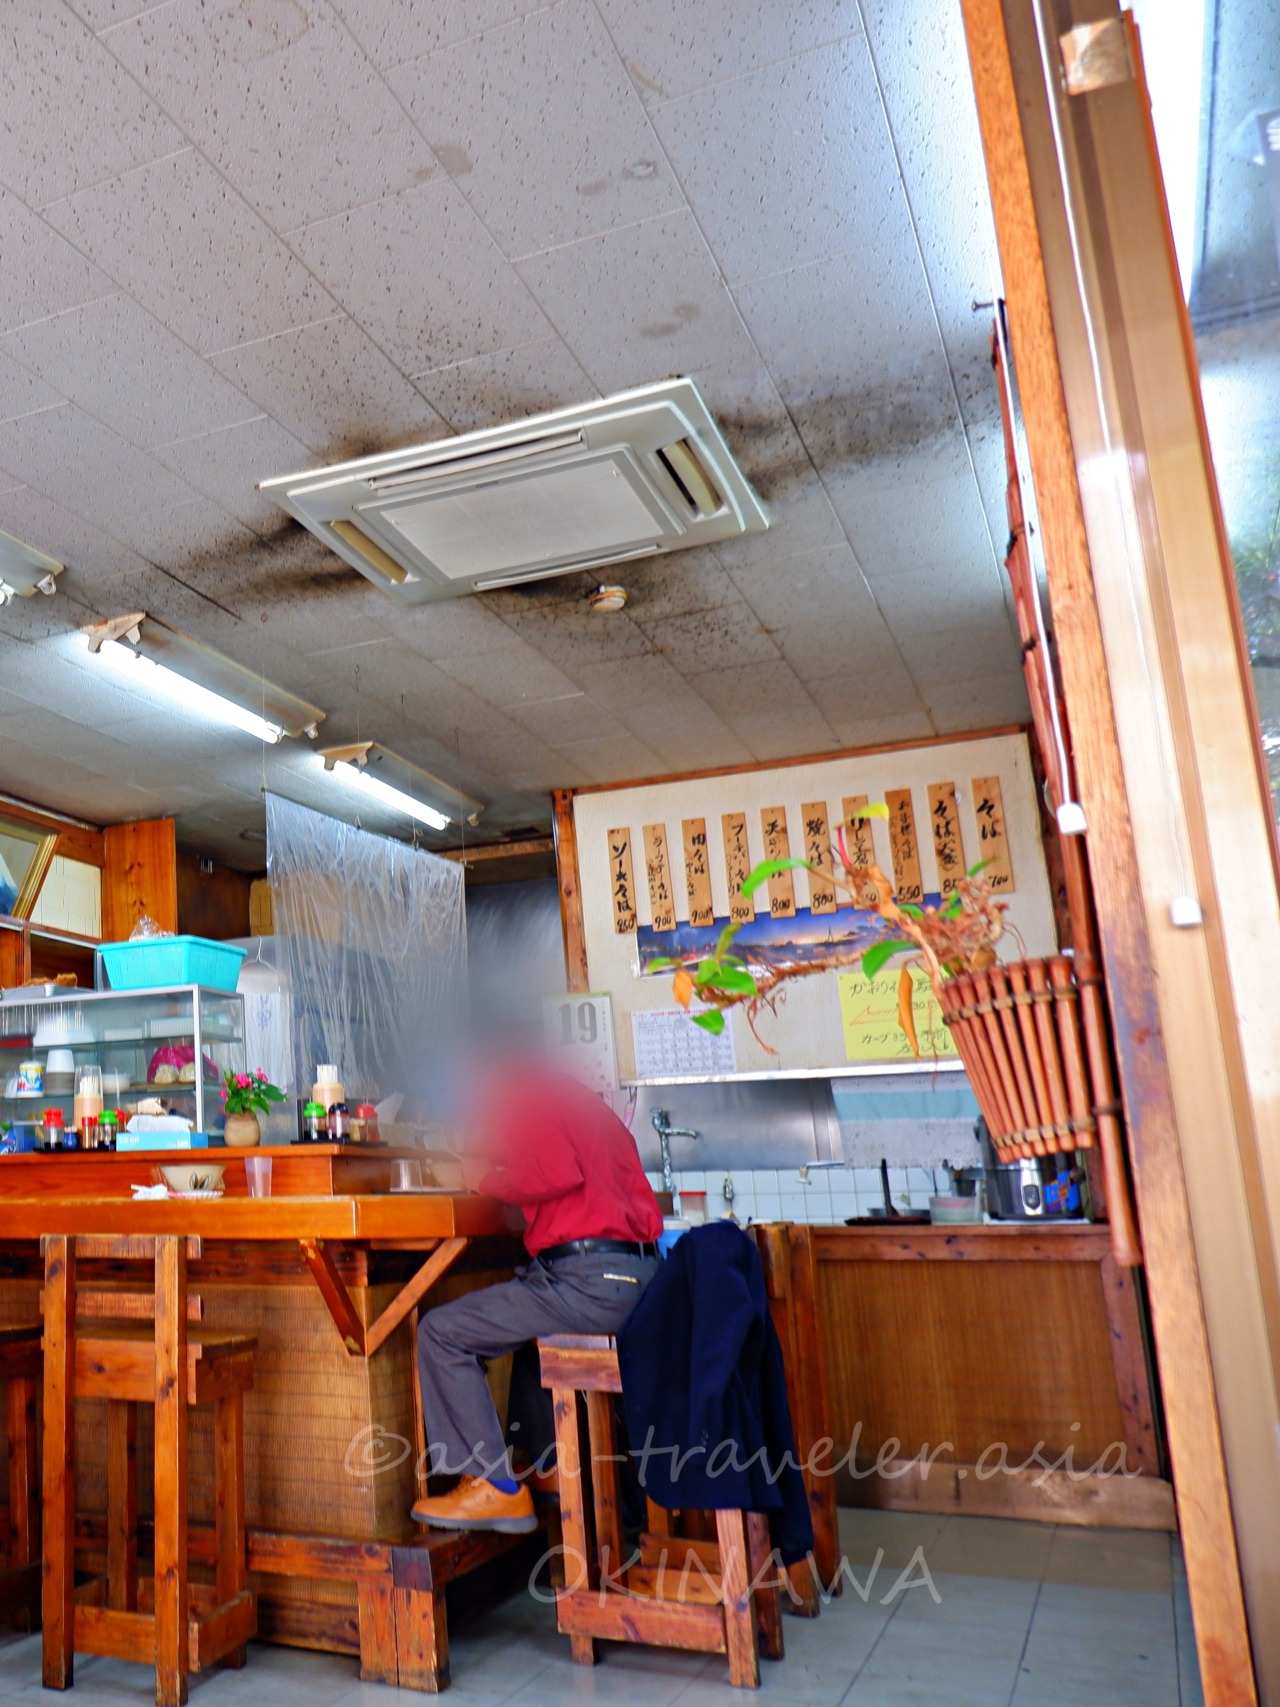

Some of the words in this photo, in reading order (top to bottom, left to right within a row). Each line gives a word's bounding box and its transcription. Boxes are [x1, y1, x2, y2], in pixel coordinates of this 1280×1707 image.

[977, 799, 1002, 841] そば
[988, 874, 1009, 888] 700
[897, 885, 921, 901] 550
[771, 898, 791, 913] 800
[813, 893, 834, 909] 800
[691, 909, 709, 923] 900
[731, 907, 750, 919] 800
[654, 916, 672, 929] 900
[558, 1001, 598, 1045] 19
